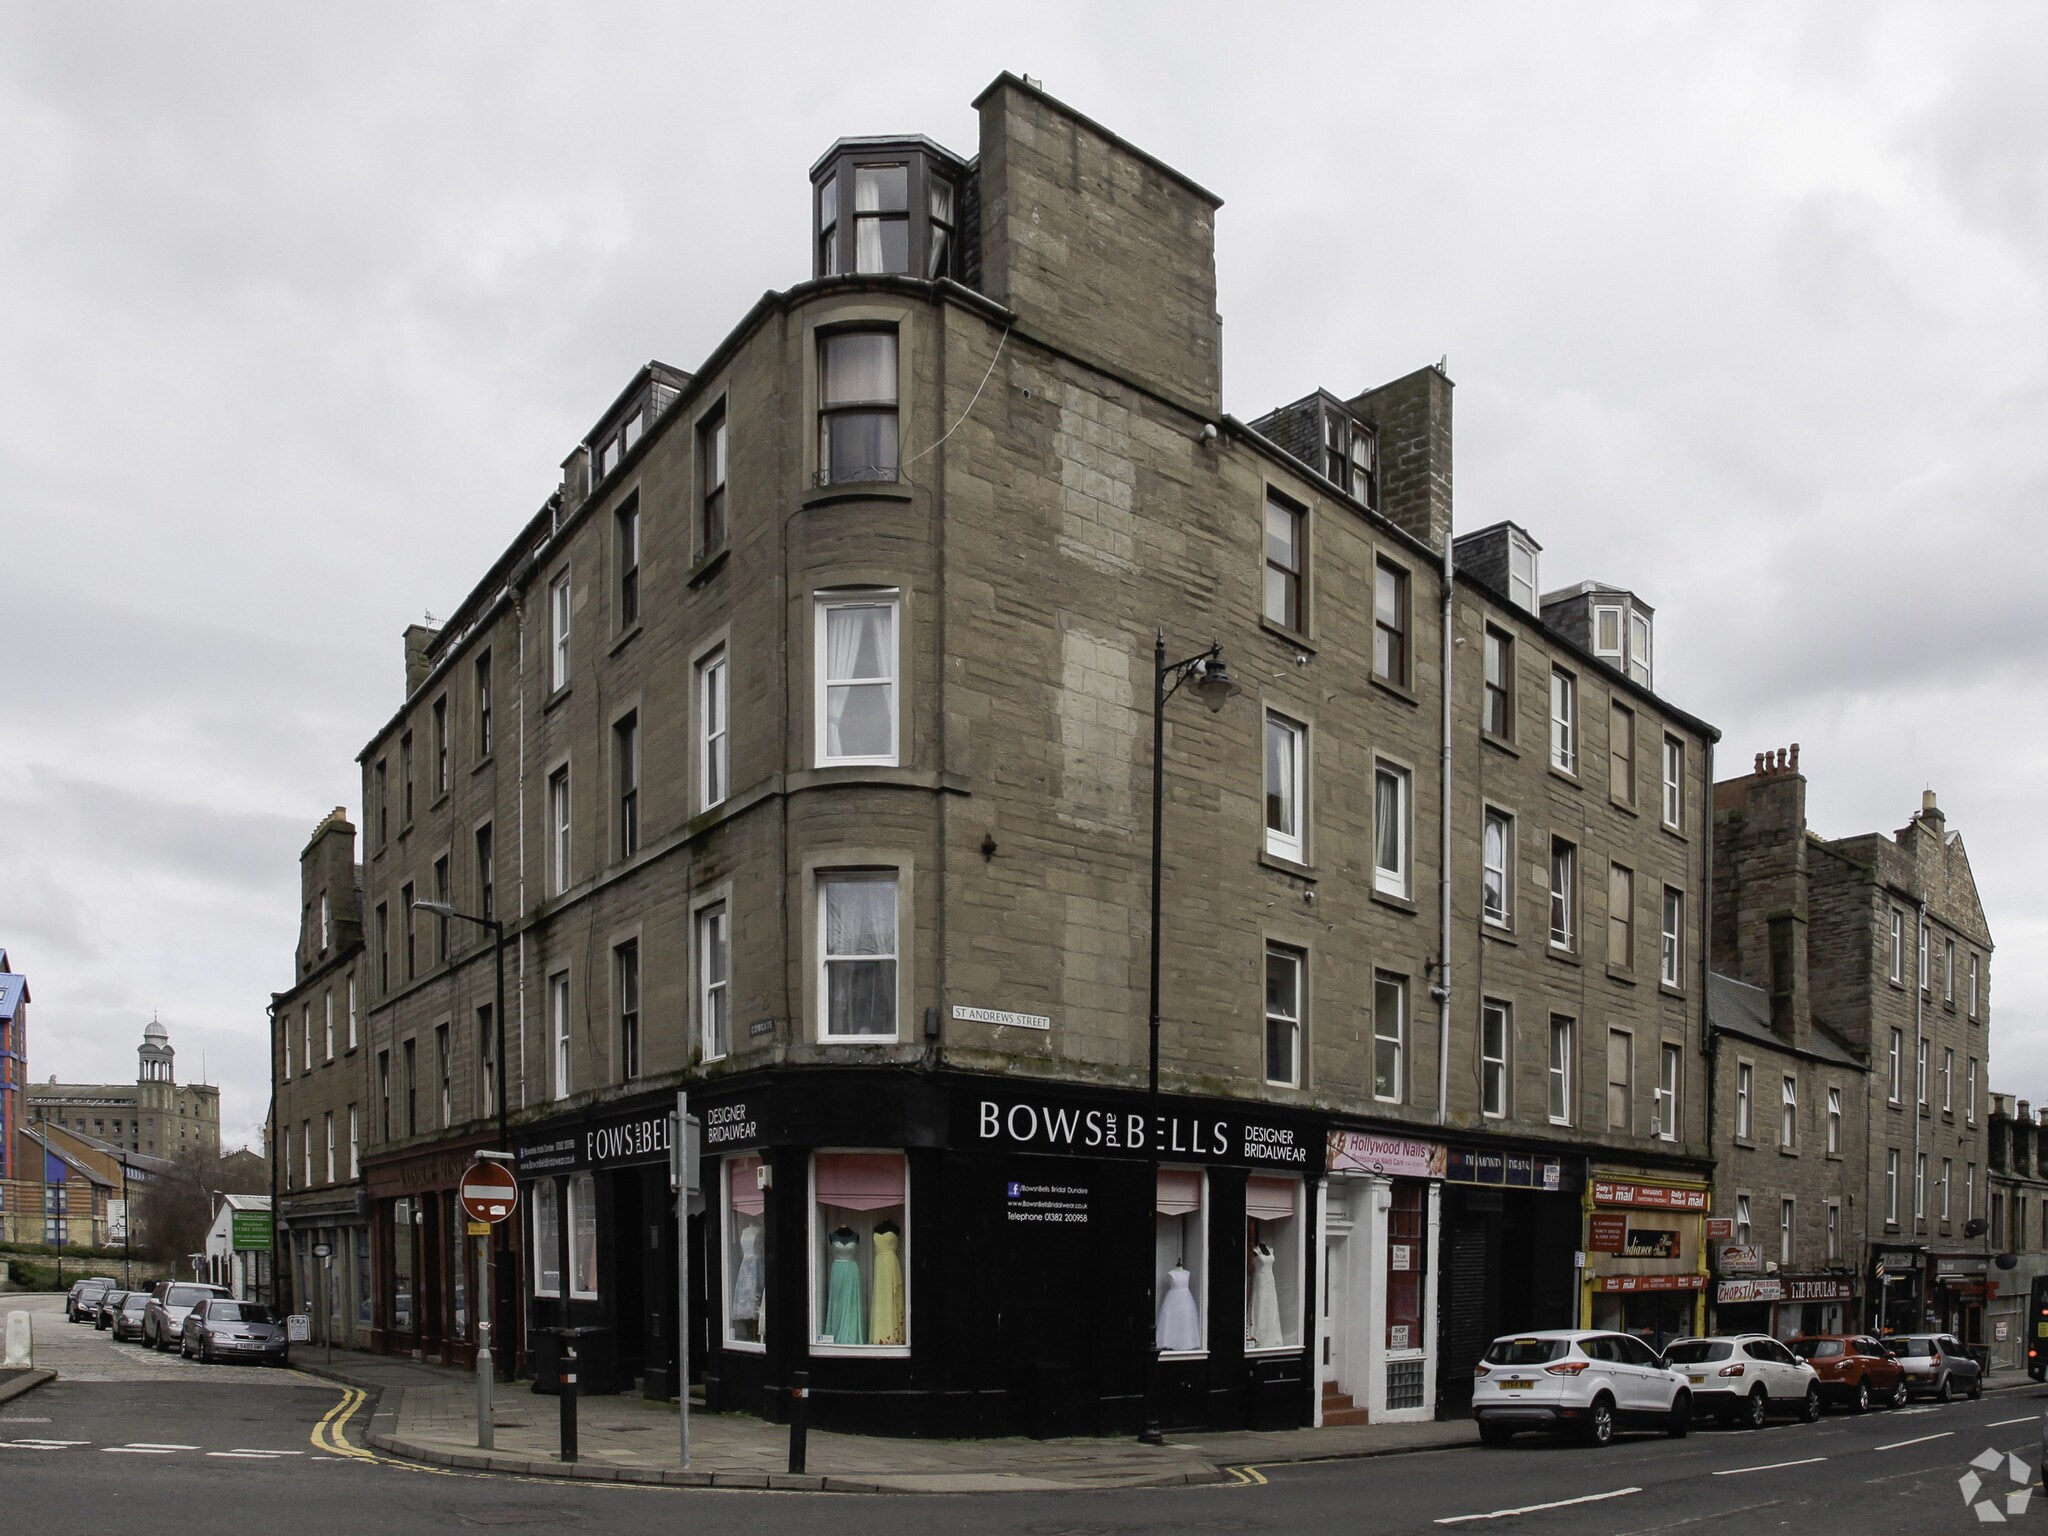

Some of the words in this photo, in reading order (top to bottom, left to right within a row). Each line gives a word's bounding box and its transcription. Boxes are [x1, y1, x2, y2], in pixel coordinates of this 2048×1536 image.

[955, 1007, 966, 1017] ST
[969, 1009, 1014, 1023] ANDREWS
[1016, 1015, 1047, 1028] STREET
[750, 1020, 773, 1034] COWGATE
[708, 1104, 746, 1125] DESIGNER
[642, 1118, 671, 1152] BEL
[708, 1121, 757, 1143] BRIDALWEAR
[979, 1101, 1102, 1146] BOWS
[1105, 1112, 1121, 1147] and
[1126, 1114, 1228, 1155] BELLS
[1244, 1125, 1294, 1145] DESIGNER
[1244, 1142, 1306, 1163] BRIDALWEAR
[1350, 1135, 1400, 1155] Hollywood
[1402, 1141, 1426, 1157] Nails
[1381, 1156, 1392, 1165] Nails
[1051, 1185, 1066, 1193] Bridal
[1067, 1186, 1089, 1194] Dundee
[1595, 1191, 1613, 1200] Record
[1596, 1183, 1609, 1193] Daily
[1615, 1187, 1635, 1201] mail
[1671, 1190, 1682, 1199] Daily
[1670, 1197, 1686, 1206] Record
[1687, 1193, 1704, 1207] mail
[1008, 1211, 1043, 1222] Telephone
[1044, 1212, 1063, 1221] 01382
[1064, 1213, 1088, 1223] 200958
[1721, 1246, 1757, 1261] CHOPSTIX
[1718, 1281, 1757, 1302] CHOPSTIX
[1790, 1282, 1806, 1298] THE
[1806, 1281, 1837, 1298] POPULAR
